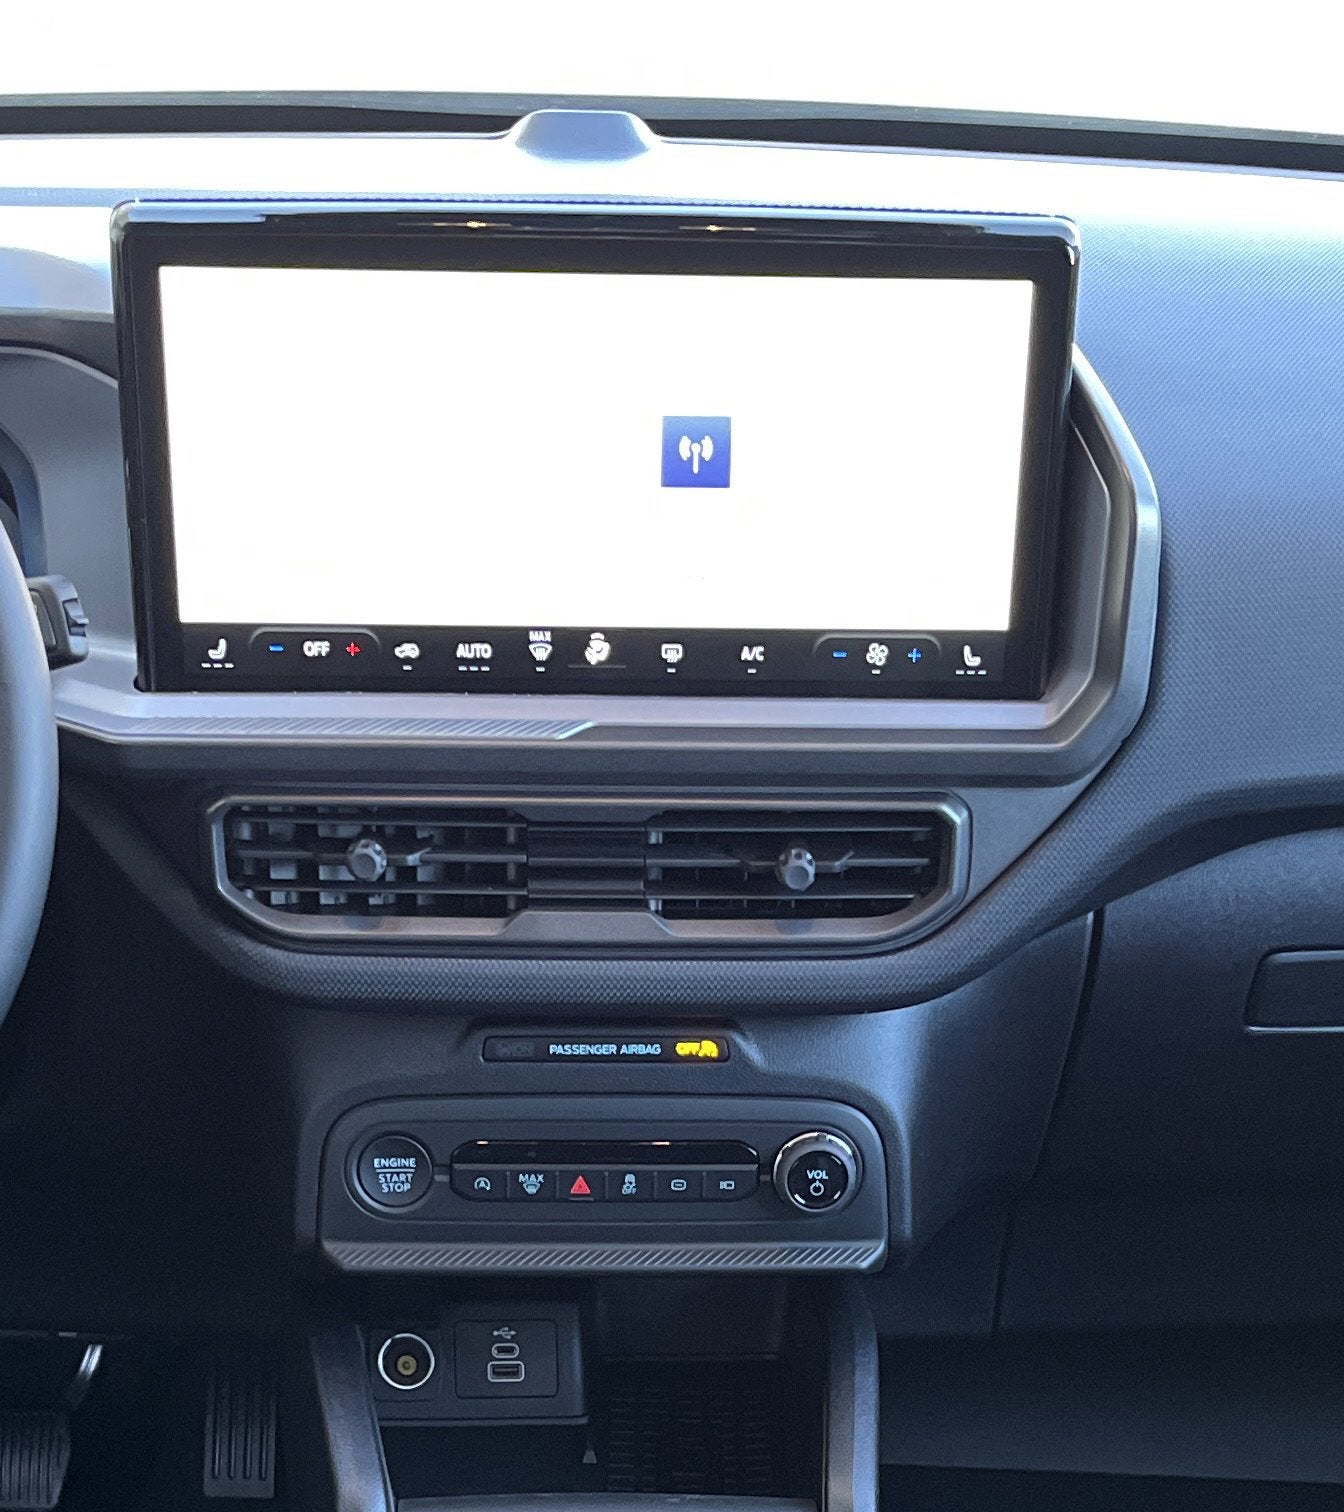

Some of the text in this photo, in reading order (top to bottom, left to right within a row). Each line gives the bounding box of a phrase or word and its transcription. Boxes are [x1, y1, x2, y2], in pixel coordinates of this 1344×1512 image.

[528, 630, 551, 642] MAX
[303, 641, 330, 657] OFF
[456, 643, 492, 659] AUTO
[741, 645, 765, 661] A/C
[549, 1044, 617, 1055] PASSENGER
[620, 1044, 661, 1055] AIRBAG
[373, 1158, 416, 1168] ENGINE
[378, 1173, 413, 1183] START
[518, 1173, 544, 1183] MAX
[806, 1169, 829, 1180] VOL
[382, 1182, 411, 1193] STOP
